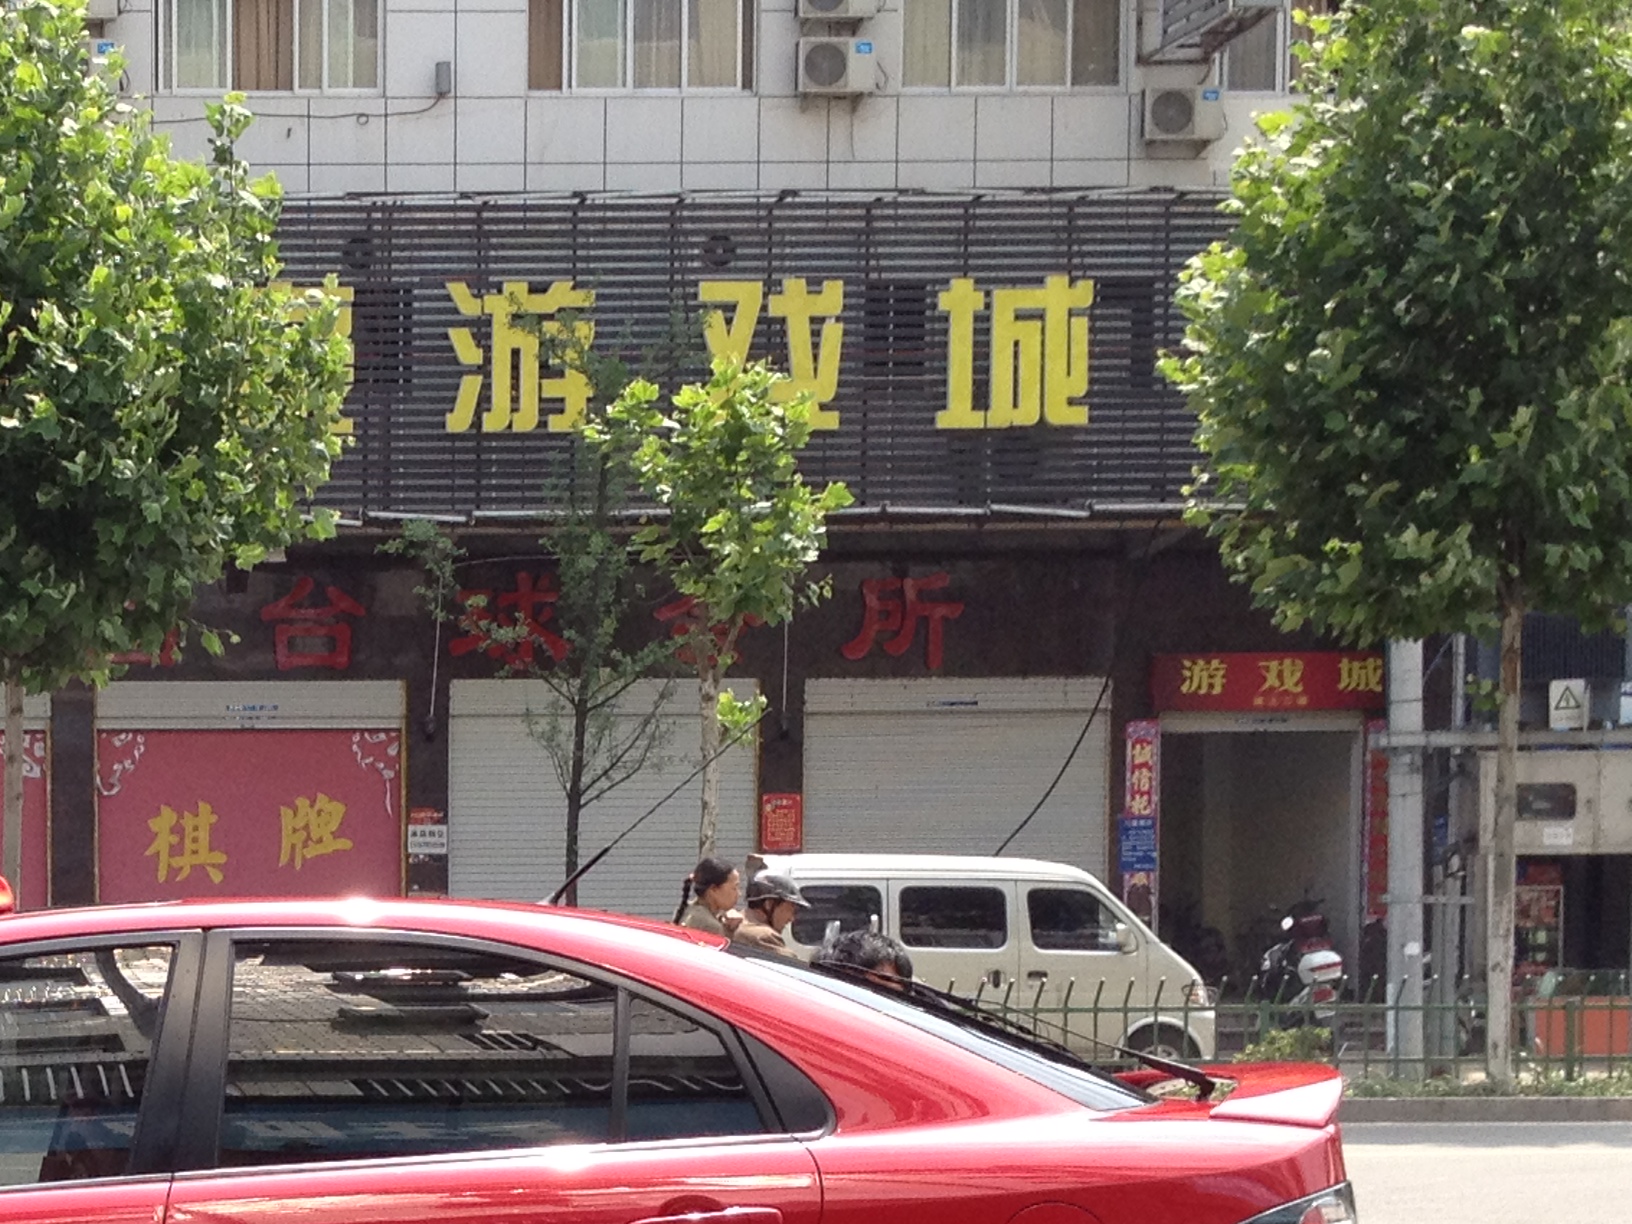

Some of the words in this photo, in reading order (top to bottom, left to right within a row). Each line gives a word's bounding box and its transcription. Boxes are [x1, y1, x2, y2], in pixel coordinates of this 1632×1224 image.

[1179, 657, 1384, 696] 游戏城
[143, 792, 354, 884] 棋牌
